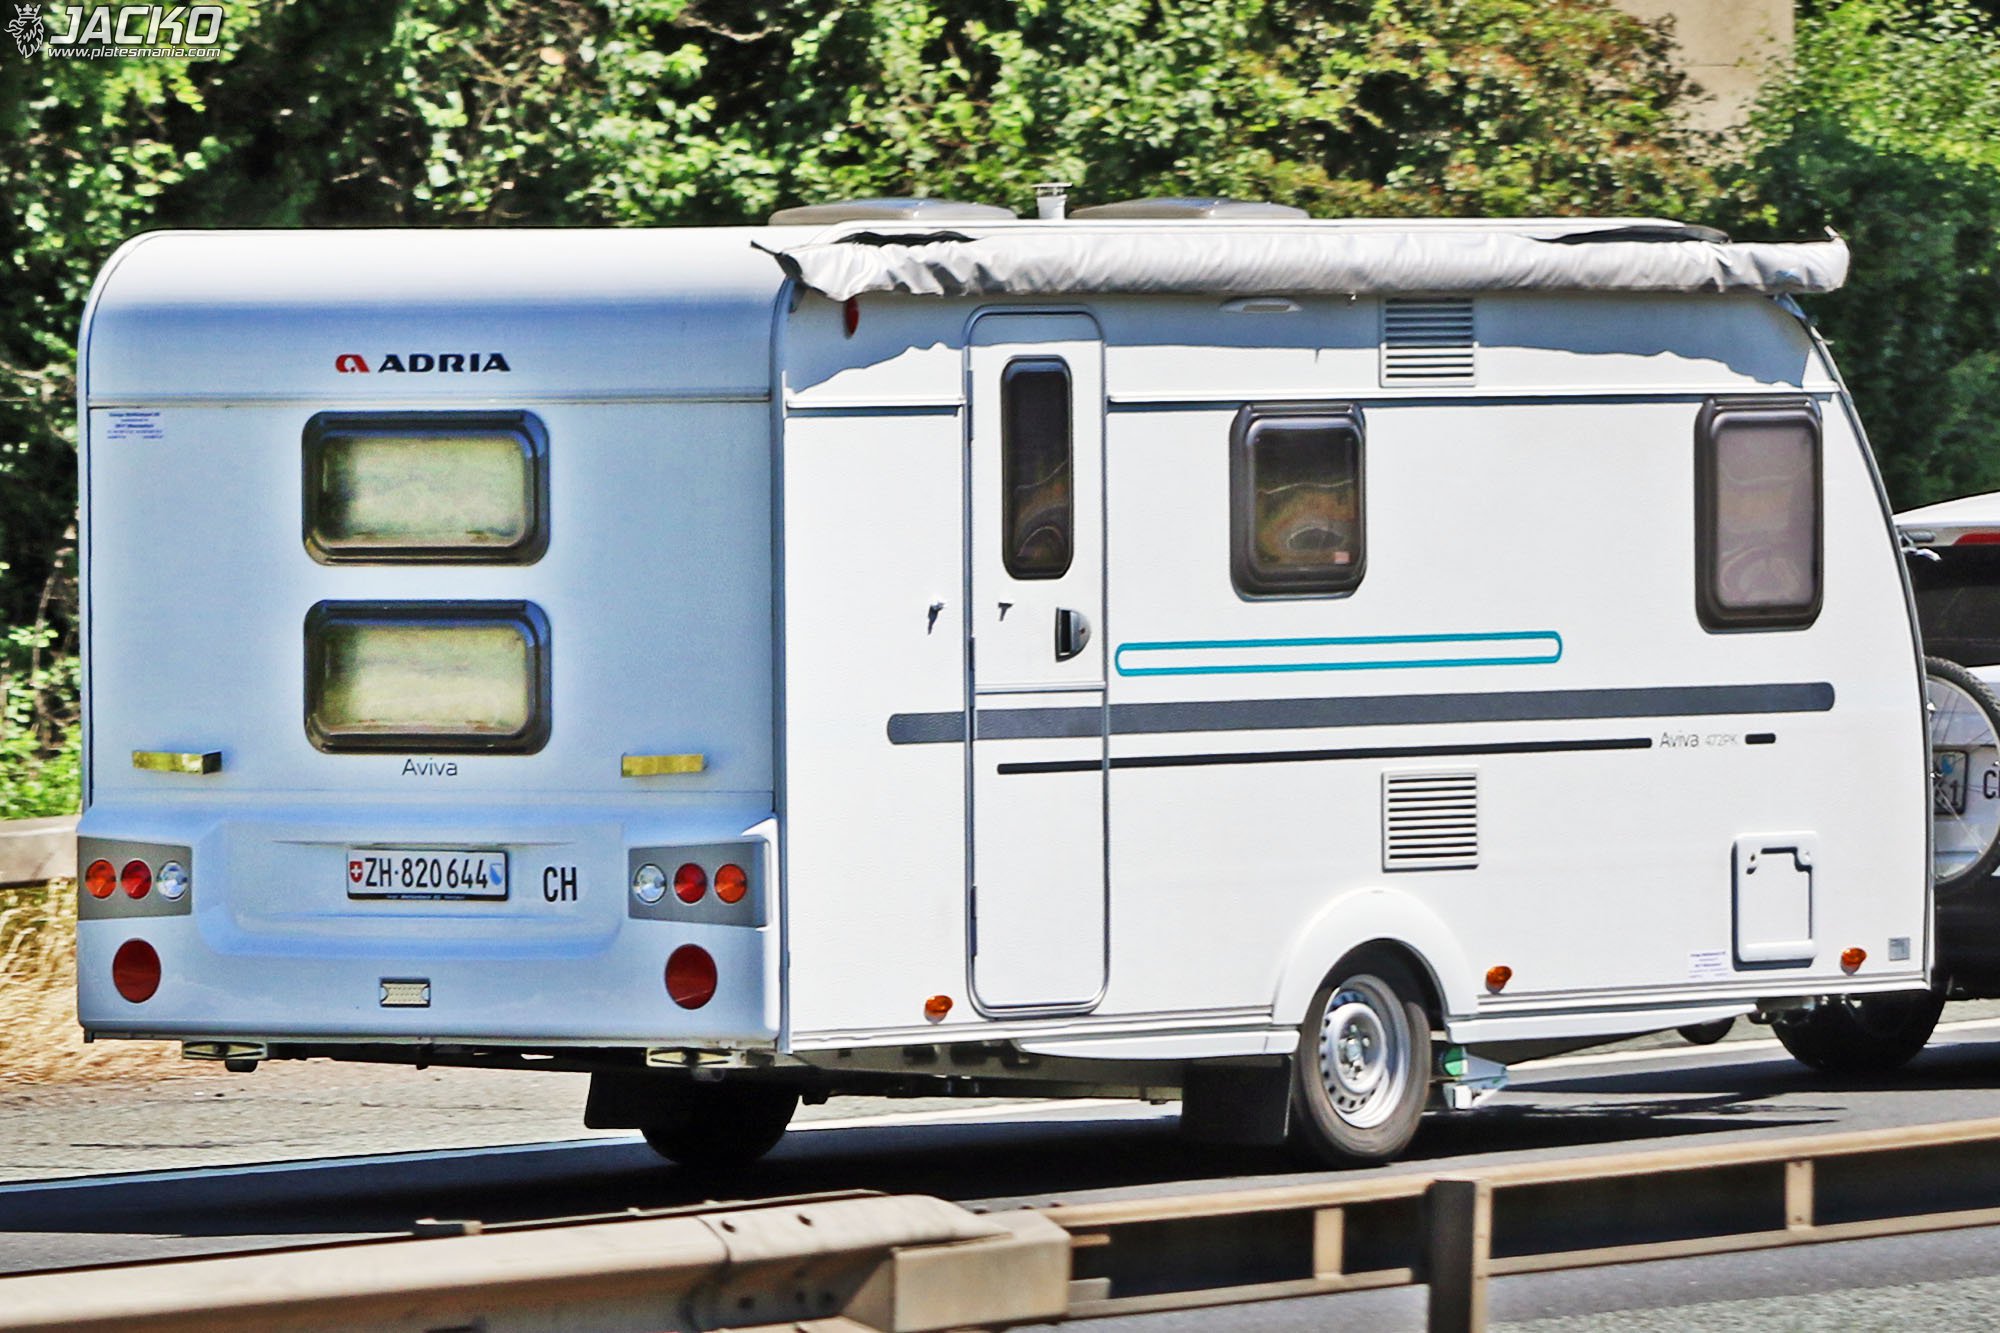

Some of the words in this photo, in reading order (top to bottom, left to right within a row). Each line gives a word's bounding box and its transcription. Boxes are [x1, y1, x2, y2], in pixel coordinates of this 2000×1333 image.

[378, 353, 511, 373] ADRIA
[1660, 731, 1700, 748] Aviva
[402, 757, 458, 777] Aviva
[1984, 769, 2000, 799] C
[543, 866, 578, 902] CH
